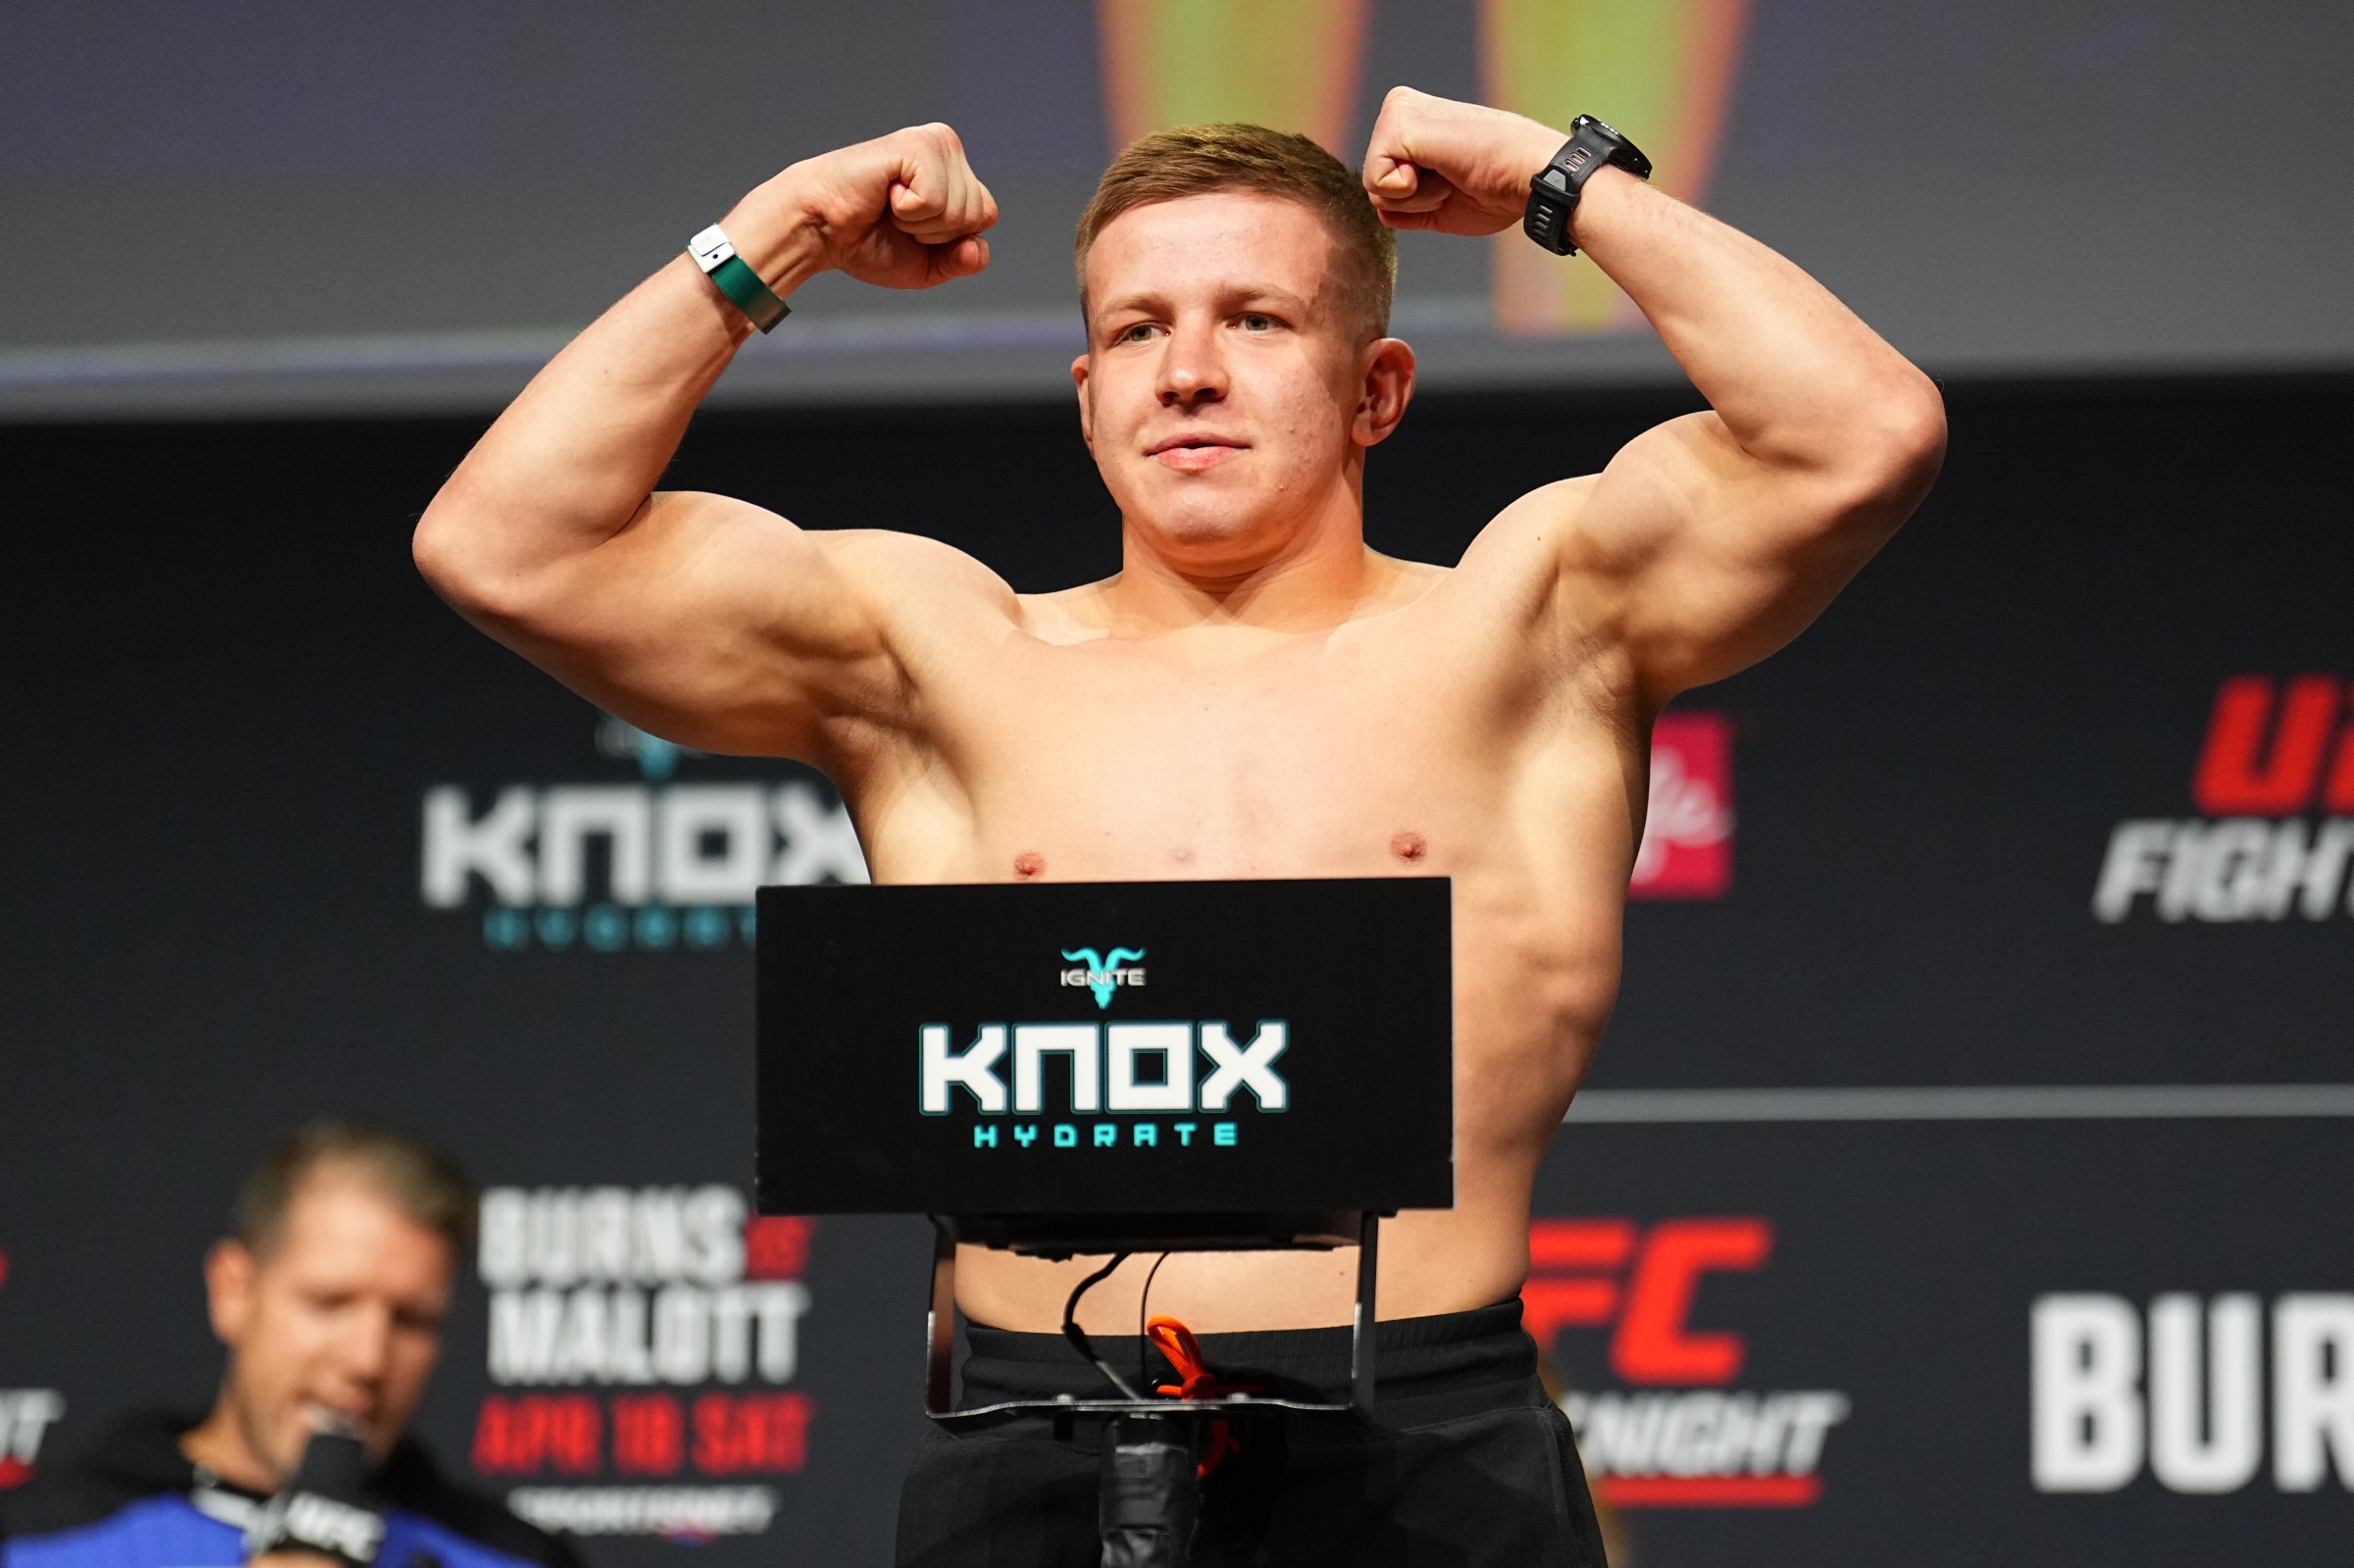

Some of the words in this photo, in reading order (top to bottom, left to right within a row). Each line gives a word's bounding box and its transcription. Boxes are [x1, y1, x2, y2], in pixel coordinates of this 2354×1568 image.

[2191, 674, 2354, 817] U
[422, 784, 871, 908] KNOX
[2091, 817, 2354, 924] FIGH
[1060, 968, 1146, 986] IGNITE
[919, 1021, 1289, 1115] KNOX
[974, 1123, 1237, 1148] HYDRATE
[479, 1185, 748, 1290] BURNS
[488, 1279, 811, 1388] MALOTT
[691, 1391, 815, 1477] SAT
